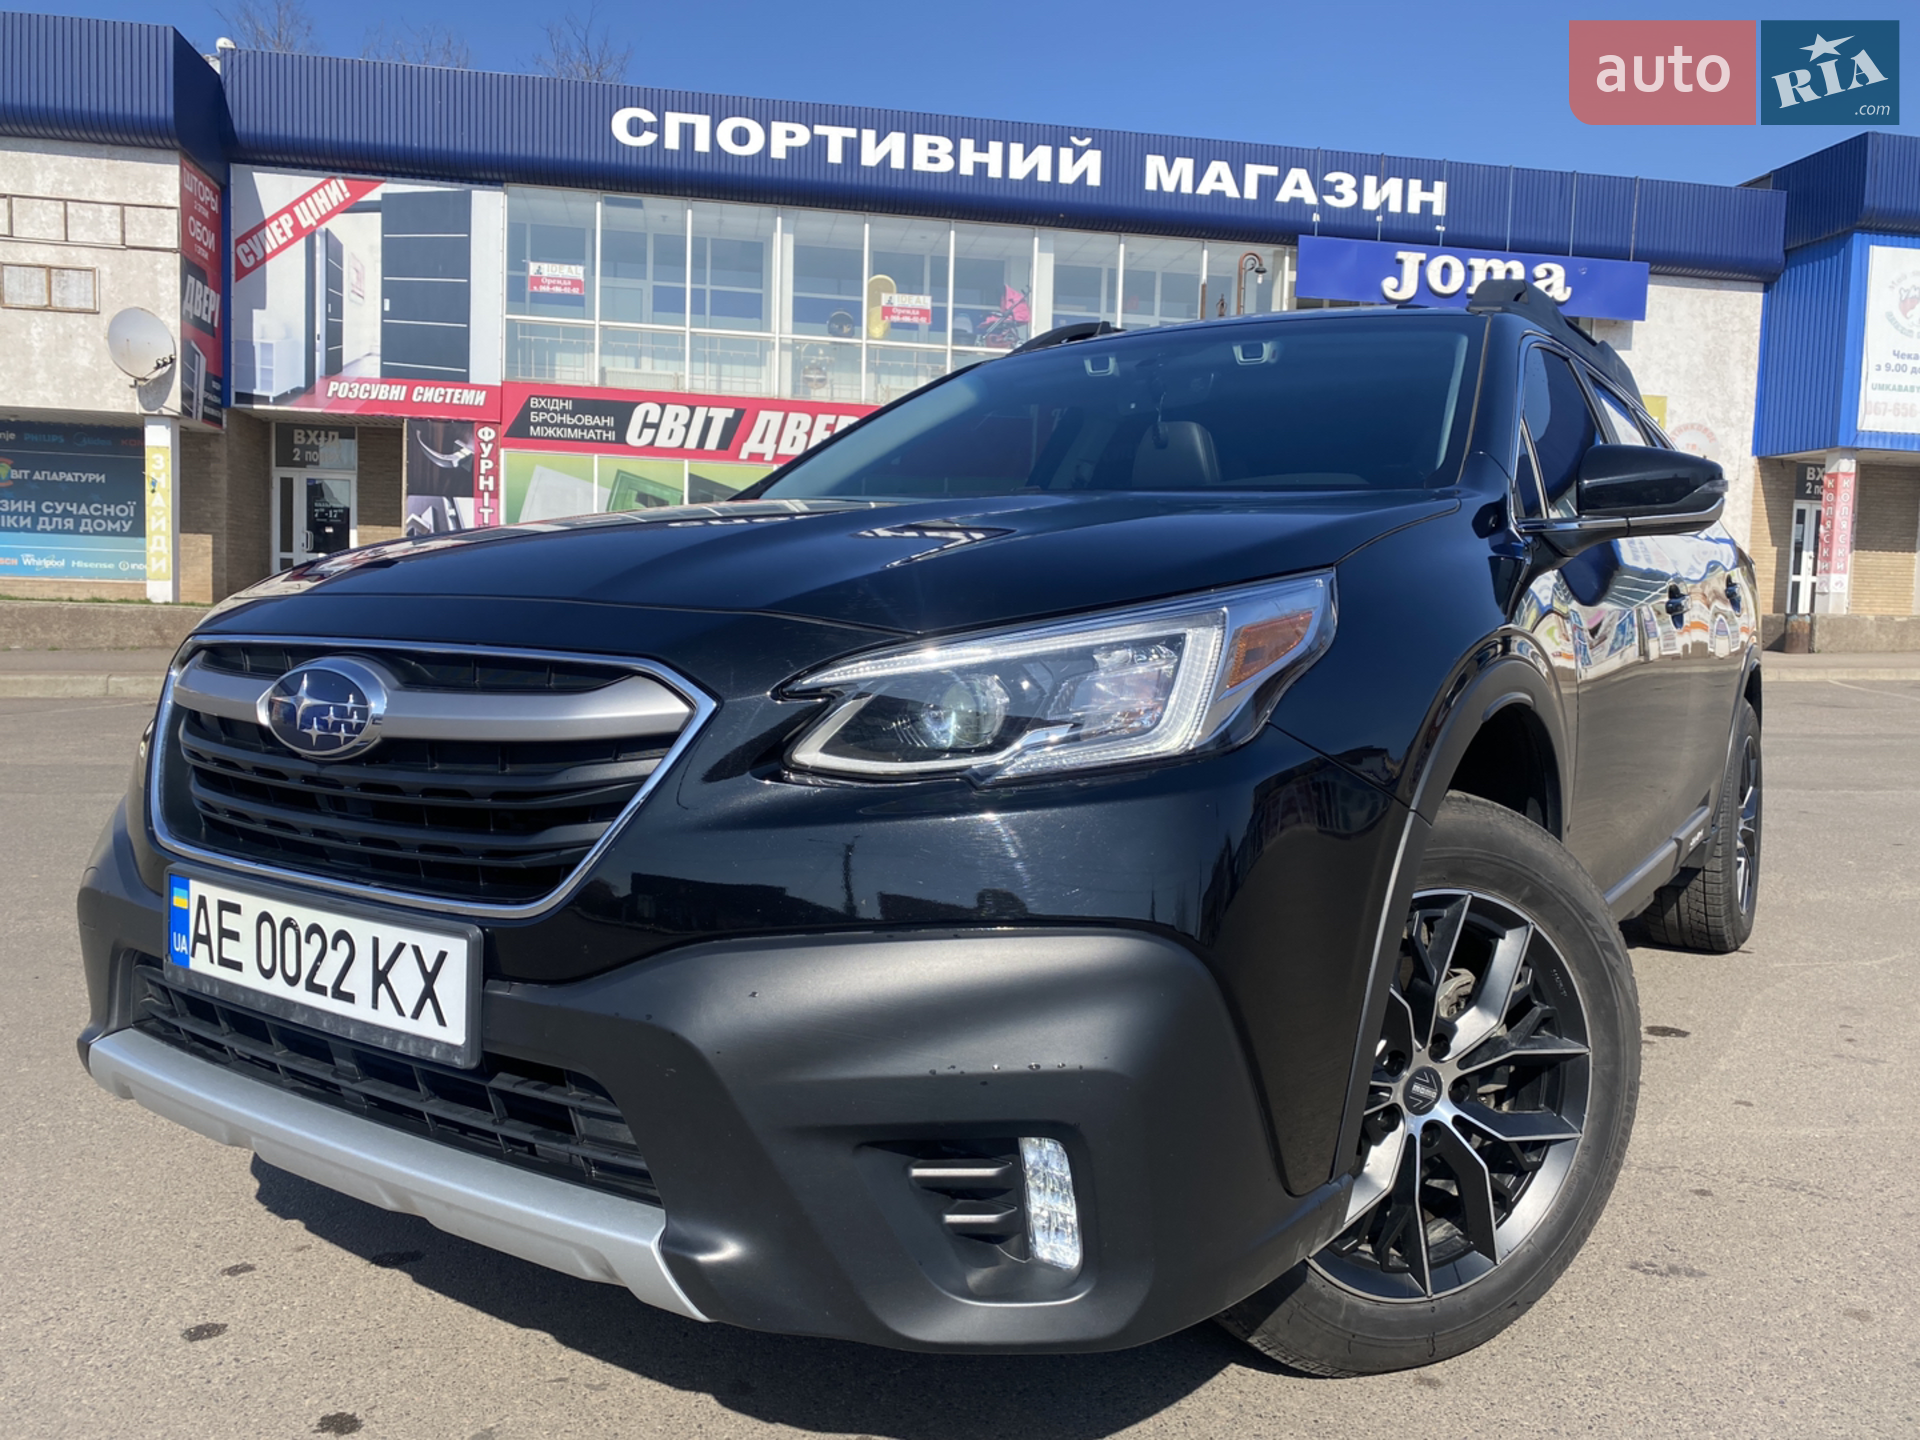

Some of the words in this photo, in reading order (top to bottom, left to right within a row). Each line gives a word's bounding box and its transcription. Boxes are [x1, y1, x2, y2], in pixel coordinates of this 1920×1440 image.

[610, 106, 1103, 187] СПОРТИВНИЙ
[1144, 153, 1448, 216] МАГАЗИН
[183, 166, 219, 214] ШТОРЫ
[236, 212, 295, 269] СУПЕР
[292, 178, 351, 229] ЦІНИ!
[188, 215, 216, 253] ОБОИ
[546, 264, 581, 275] IDEAL
[1380, 251, 1573, 302] Joma
[540, 277, 572, 286] Оренда
[182, 274, 221, 328] ДВЕРІ
[897, 295, 929, 305] IDEAL
[1885, 362, 1908, 374] 9.00
[327, 381, 408, 401] РОЗСУВНІ
[412, 386, 487, 406] СИСТЕМИ
[530, 397, 573, 412] ВХІДНІ
[530, 411, 615, 428] БРОНЬОВАНІ
[625, 402, 735, 451] СВІТ
[24, 433, 65, 444] PHILIPS
[293, 429, 340, 447] ВХІД
[530, 426, 616, 442] МІЖКІМНАТНІ
[292, 448, 301, 461] 2
[32, 470, 106, 484] АПАРАТУРИ
[477, 426, 496, 526] ФУРНІТ
[1805, 483, 1813, 495] 2
[41, 500, 137, 517] СУЧАСНОЇ
[150, 453, 169, 574] ЗНАЙДИ
[37, 516, 75, 532] ДЛЯ
[79, 519, 133, 534] ДОМУ
[1821, 479, 1835, 571] КОЛЯСКИ
[1836, 479, 1850, 571] КОЛЯСКИ
[21, 553, 65, 569] Whirlpool
[71, 560, 115, 570] Hisense
[172, 931, 189, 955] UA
[190, 893, 244, 973] AE
[255, 910, 356, 1005] 0022
[371, 935, 449, 1028] KX
